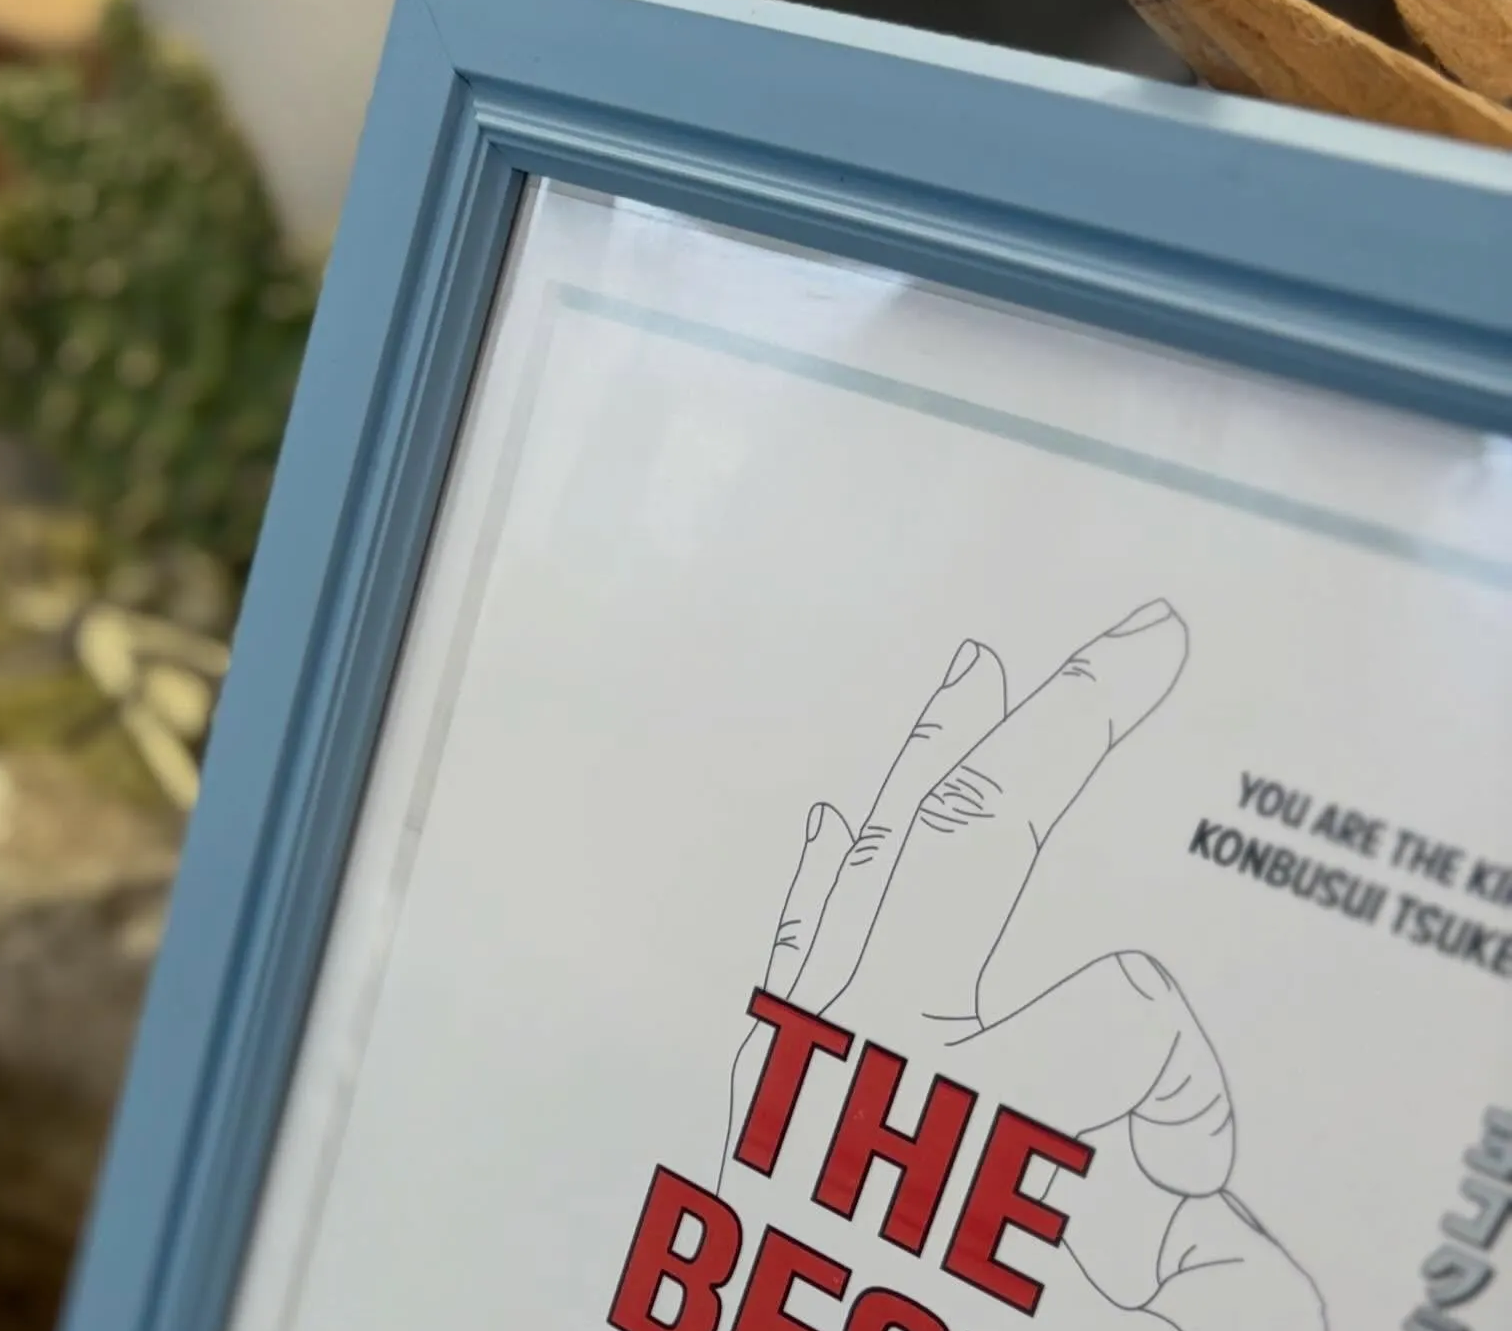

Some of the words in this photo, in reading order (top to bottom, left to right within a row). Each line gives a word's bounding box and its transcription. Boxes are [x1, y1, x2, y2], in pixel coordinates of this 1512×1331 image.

[1187, 817, 1390, 926] KONBUSUI
[1237, 770, 1313, 829] YOU
[1309, 802, 1389, 860] ARE
[1389, 827, 1468, 887] THE
[1464, 859, 1512, 909] KI
[732, 986, 1096, 1317] THE
